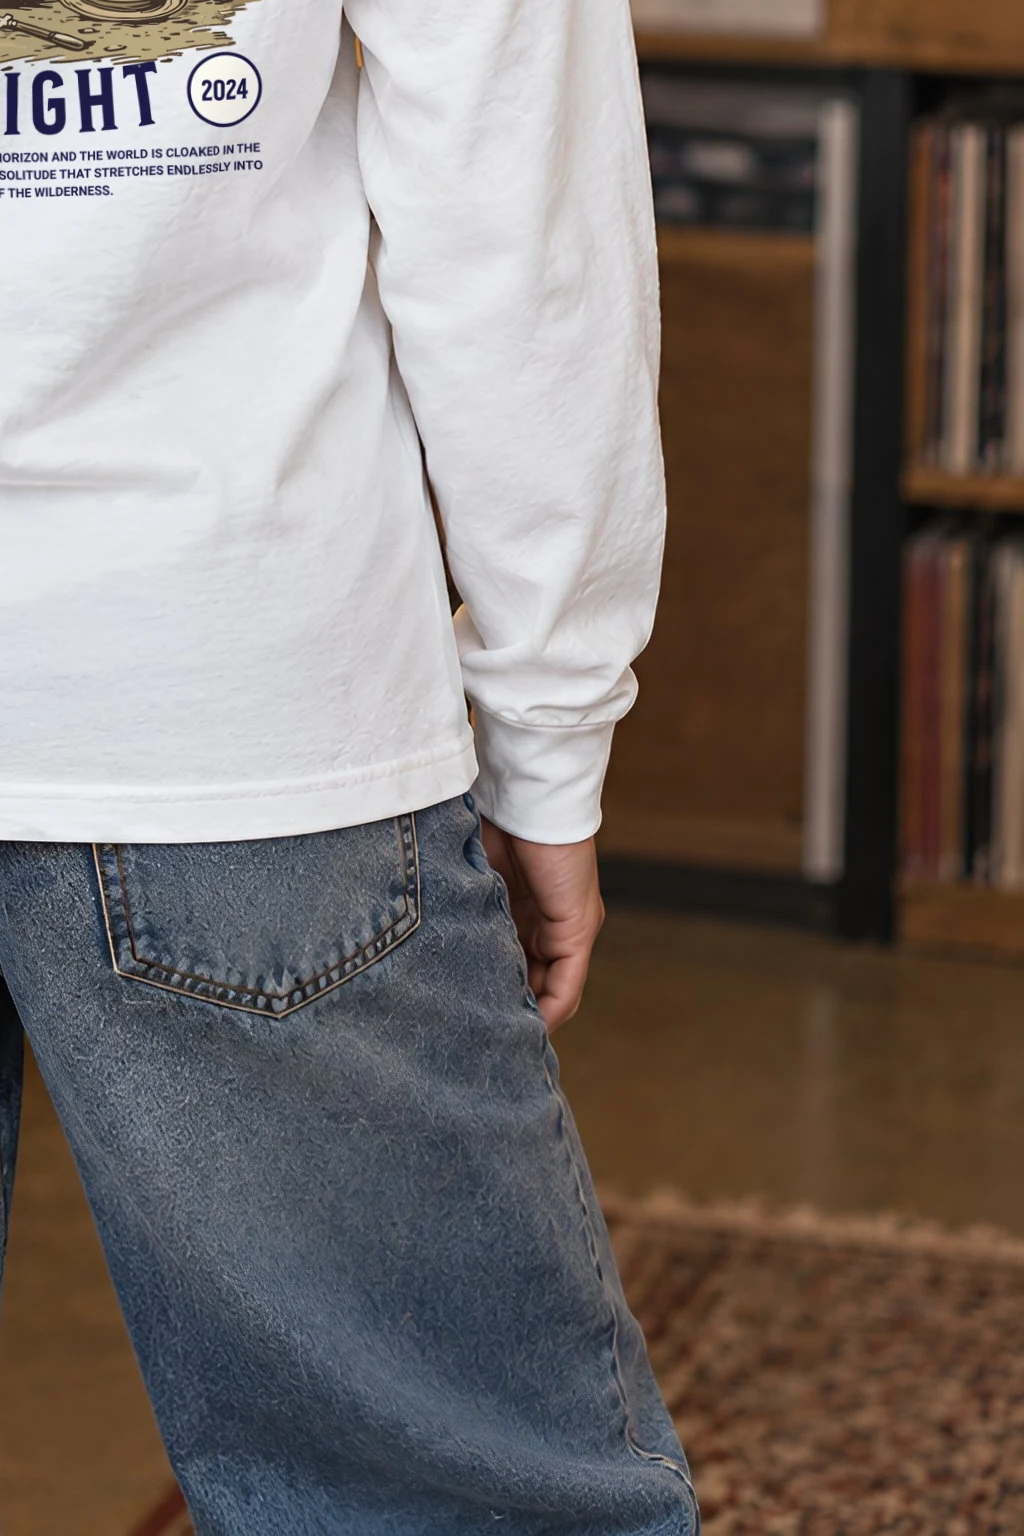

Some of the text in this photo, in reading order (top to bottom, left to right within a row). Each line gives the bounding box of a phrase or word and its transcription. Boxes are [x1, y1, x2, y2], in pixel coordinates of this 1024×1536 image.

[201, 77, 249, 101] 2024
[51, 151, 77, 162] AND
[79, 150, 103, 161] THE
[106, 149, 148, 160] WORLD
[151, 148, 163, 158] IS
[166, 145, 220, 158] CLOAKED
[223, 144, 234, 155] IN
[236, 142, 261, 154] THE
[59, 168, 91, 179] THAT
[94, 165, 164, 178] STRETCHES
[167, 161, 231, 175] ENDLESSLY
[233, 160, 263, 171] INTO
[7, 188, 32, 198] THE
[34, 185, 113, 197] WILDERNESS.
